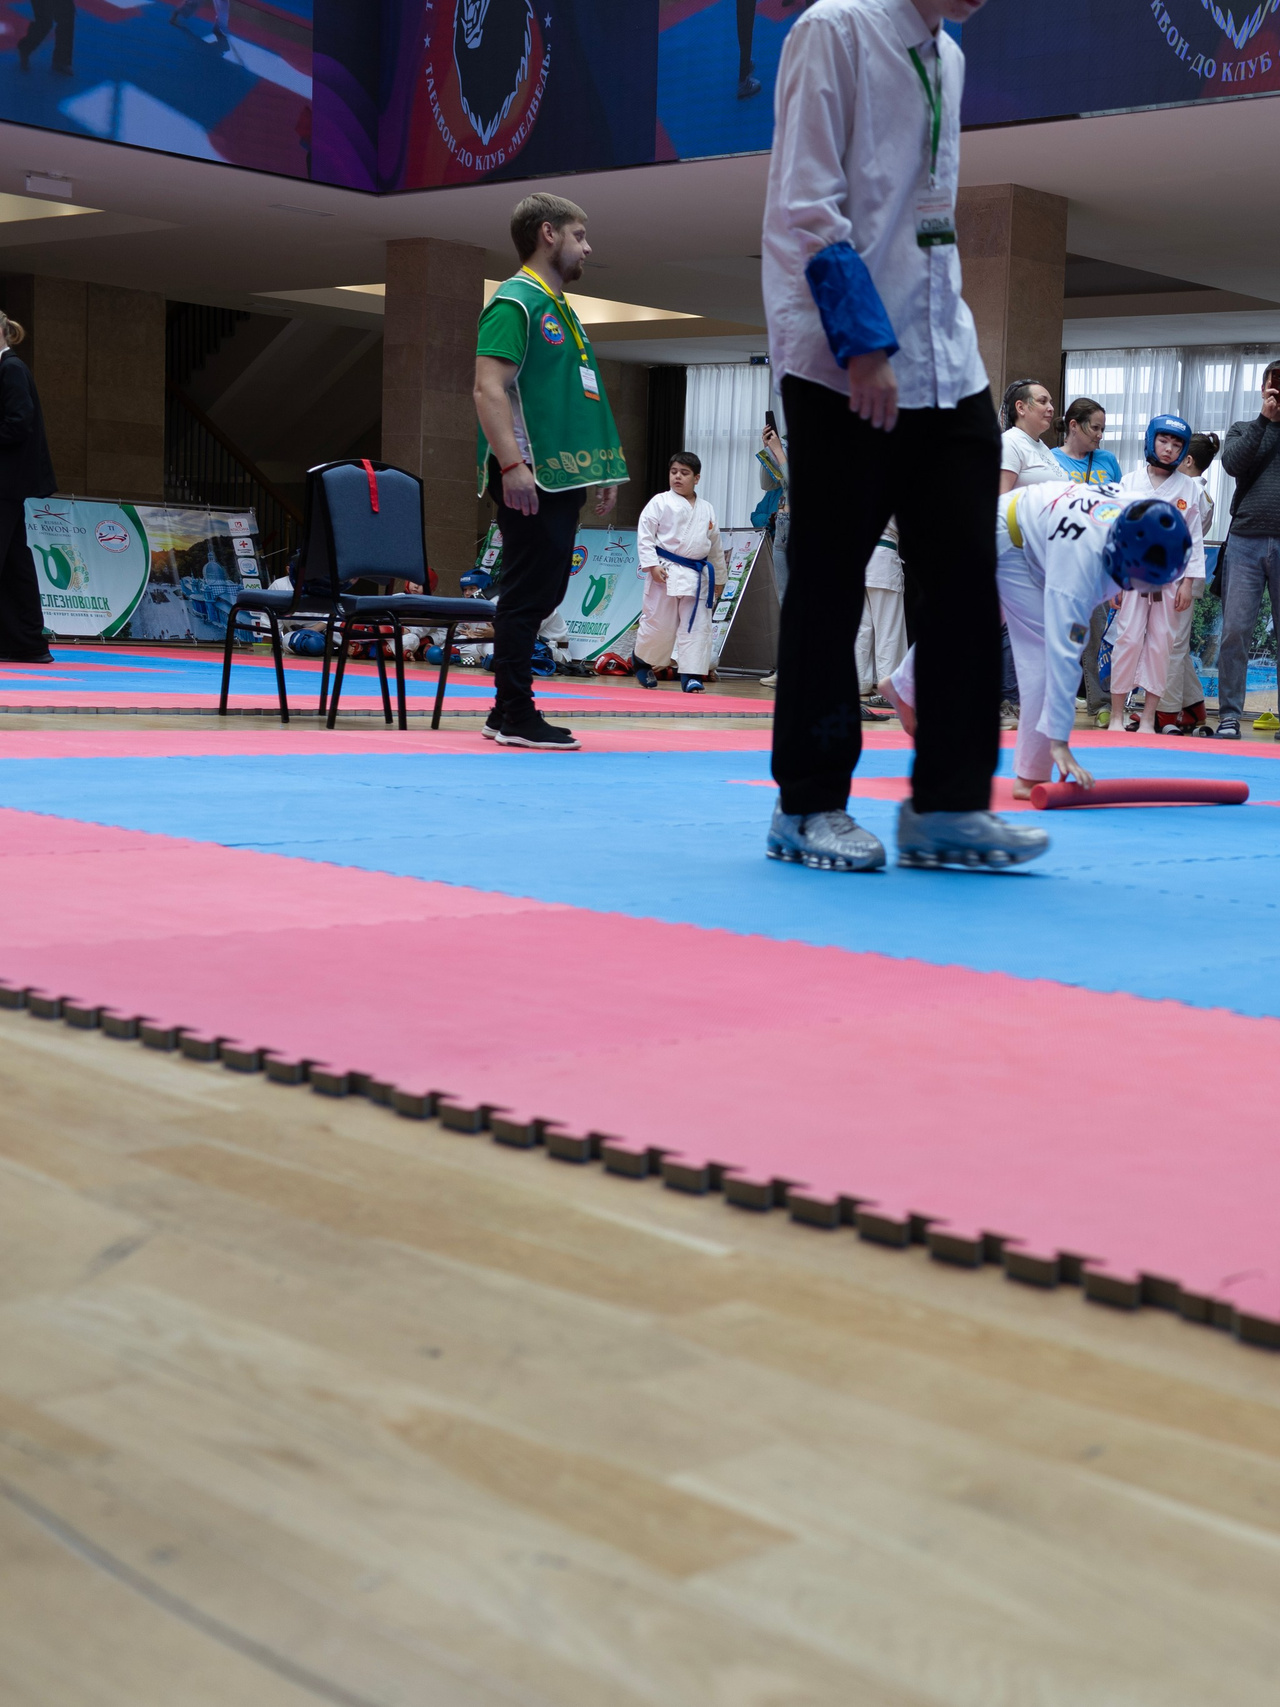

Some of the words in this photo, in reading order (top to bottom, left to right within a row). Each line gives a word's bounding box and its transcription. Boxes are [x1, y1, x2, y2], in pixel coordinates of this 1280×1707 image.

[1221, 51, 1273, 82] КЛУБ
[475, 148, 506, 171] КЛУБ
[508, 43, 552, 153] «МЕДВЕДЬ»
